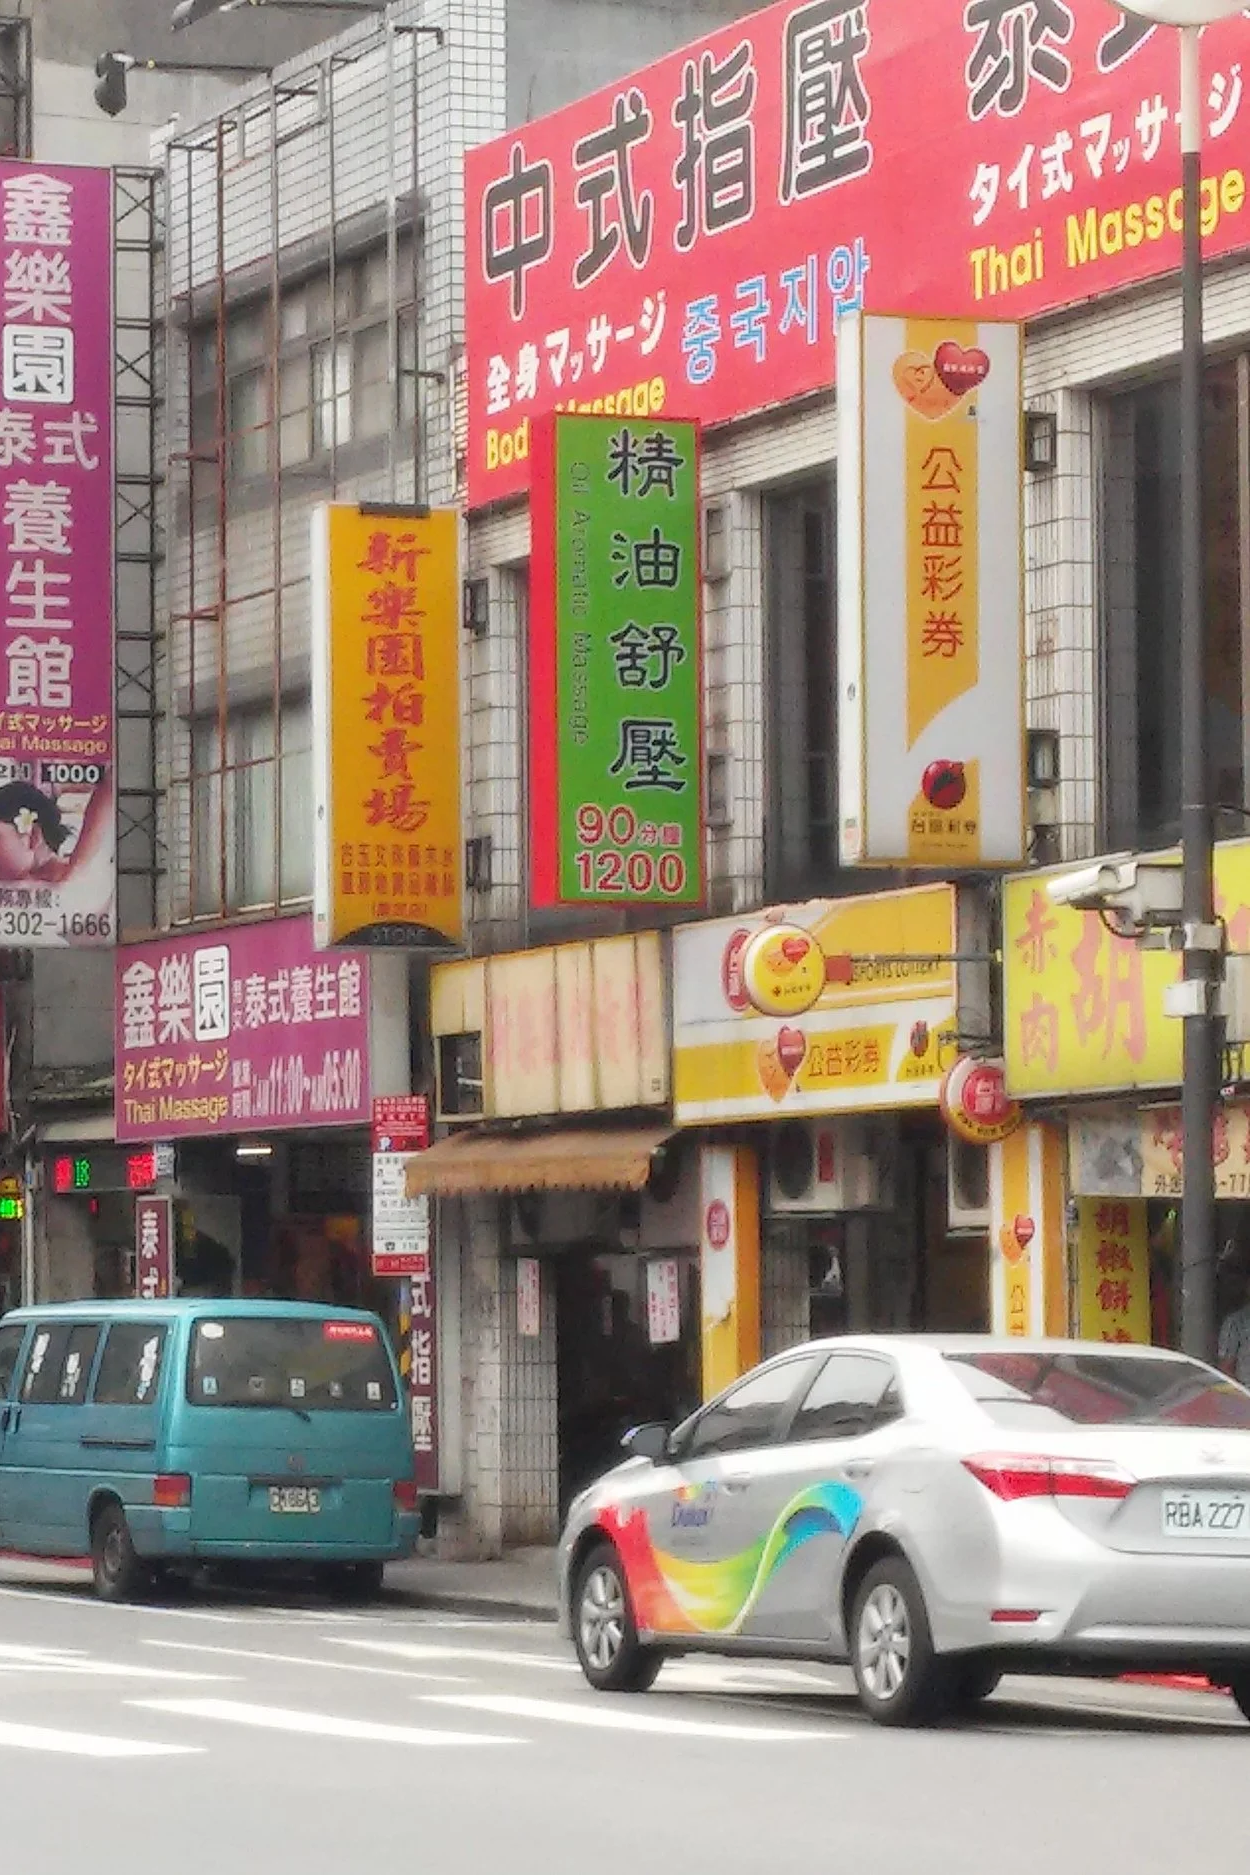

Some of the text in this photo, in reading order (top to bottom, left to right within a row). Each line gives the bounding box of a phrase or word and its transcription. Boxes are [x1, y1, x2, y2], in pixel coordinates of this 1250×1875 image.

[482, 0, 872, 322] 中式指壓
[968, 64, 1243, 227] タイ式マッサジ
[2, 174, 74, 404] 鑫樂園
[681, 238, 869, 385] 중국지압
[970, 227, 1045, 301] Thai
[486, 290, 666, 414] 全身マッサージ
[486, 418, 530, 470] Bod
[4, 480, 74, 708] 養生館
[605, 427, 687, 793] 精油舒壓
[920, 447, 964, 660] 公益彩券
[569, 631, 592, 746] Massage
[49, 764, 100, 783] 1000
[575, 850, 687, 893] 1200
[122, 944, 229, 1049] 鑫樂園
[245, 959, 361, 1030] 泰式養生館
[123, 1094, 229, 1125] Thai Massage
